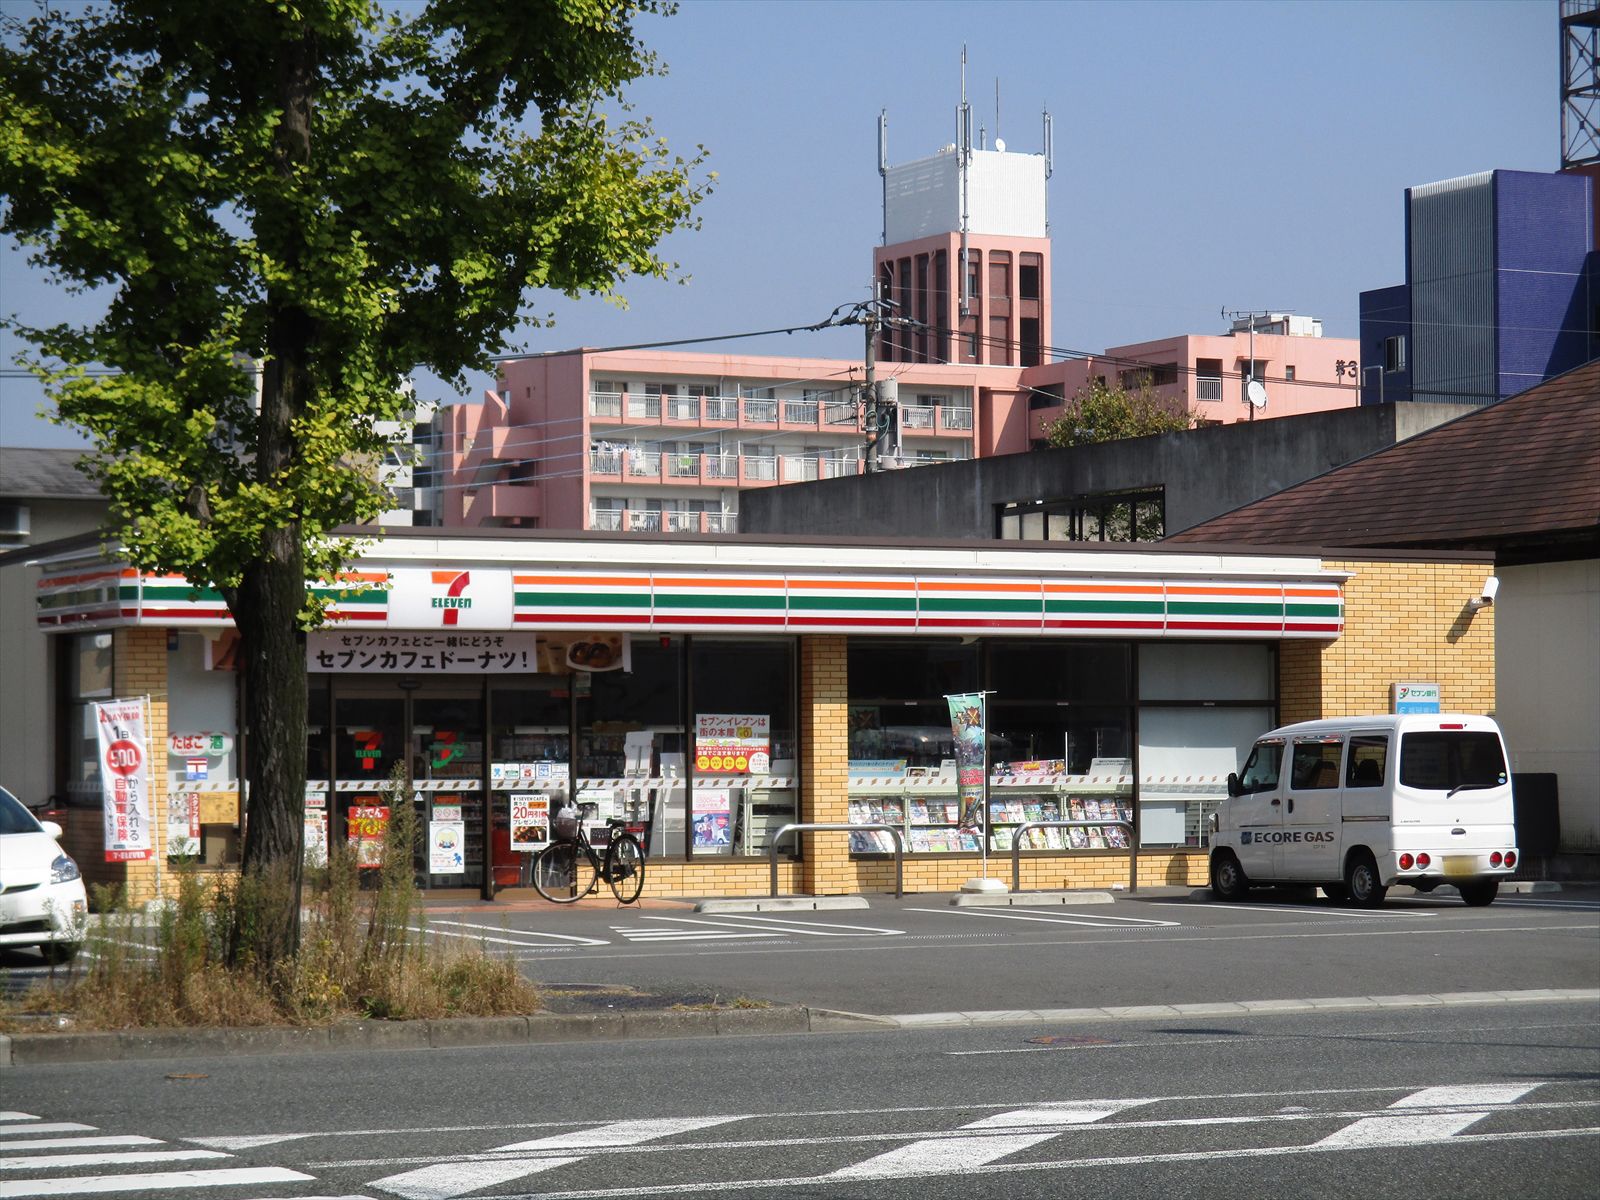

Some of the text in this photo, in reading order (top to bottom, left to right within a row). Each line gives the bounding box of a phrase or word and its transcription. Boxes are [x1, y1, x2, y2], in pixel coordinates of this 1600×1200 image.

[431, 571, 470, 625] 7
[341, 635, 504, 647] セブンカフェとご一緒にどうぞ
[316, 650, 528, 670] セブンカフェドーナツ!
[172, 735, 203, 749] たばこ
[209, 735, 224, 750] 酒
[115, 778, 129, 842] 自動車保険
[128, 778, 141, 842] から入れる
[1254, 831, 1334, 843] ECORE GAS
